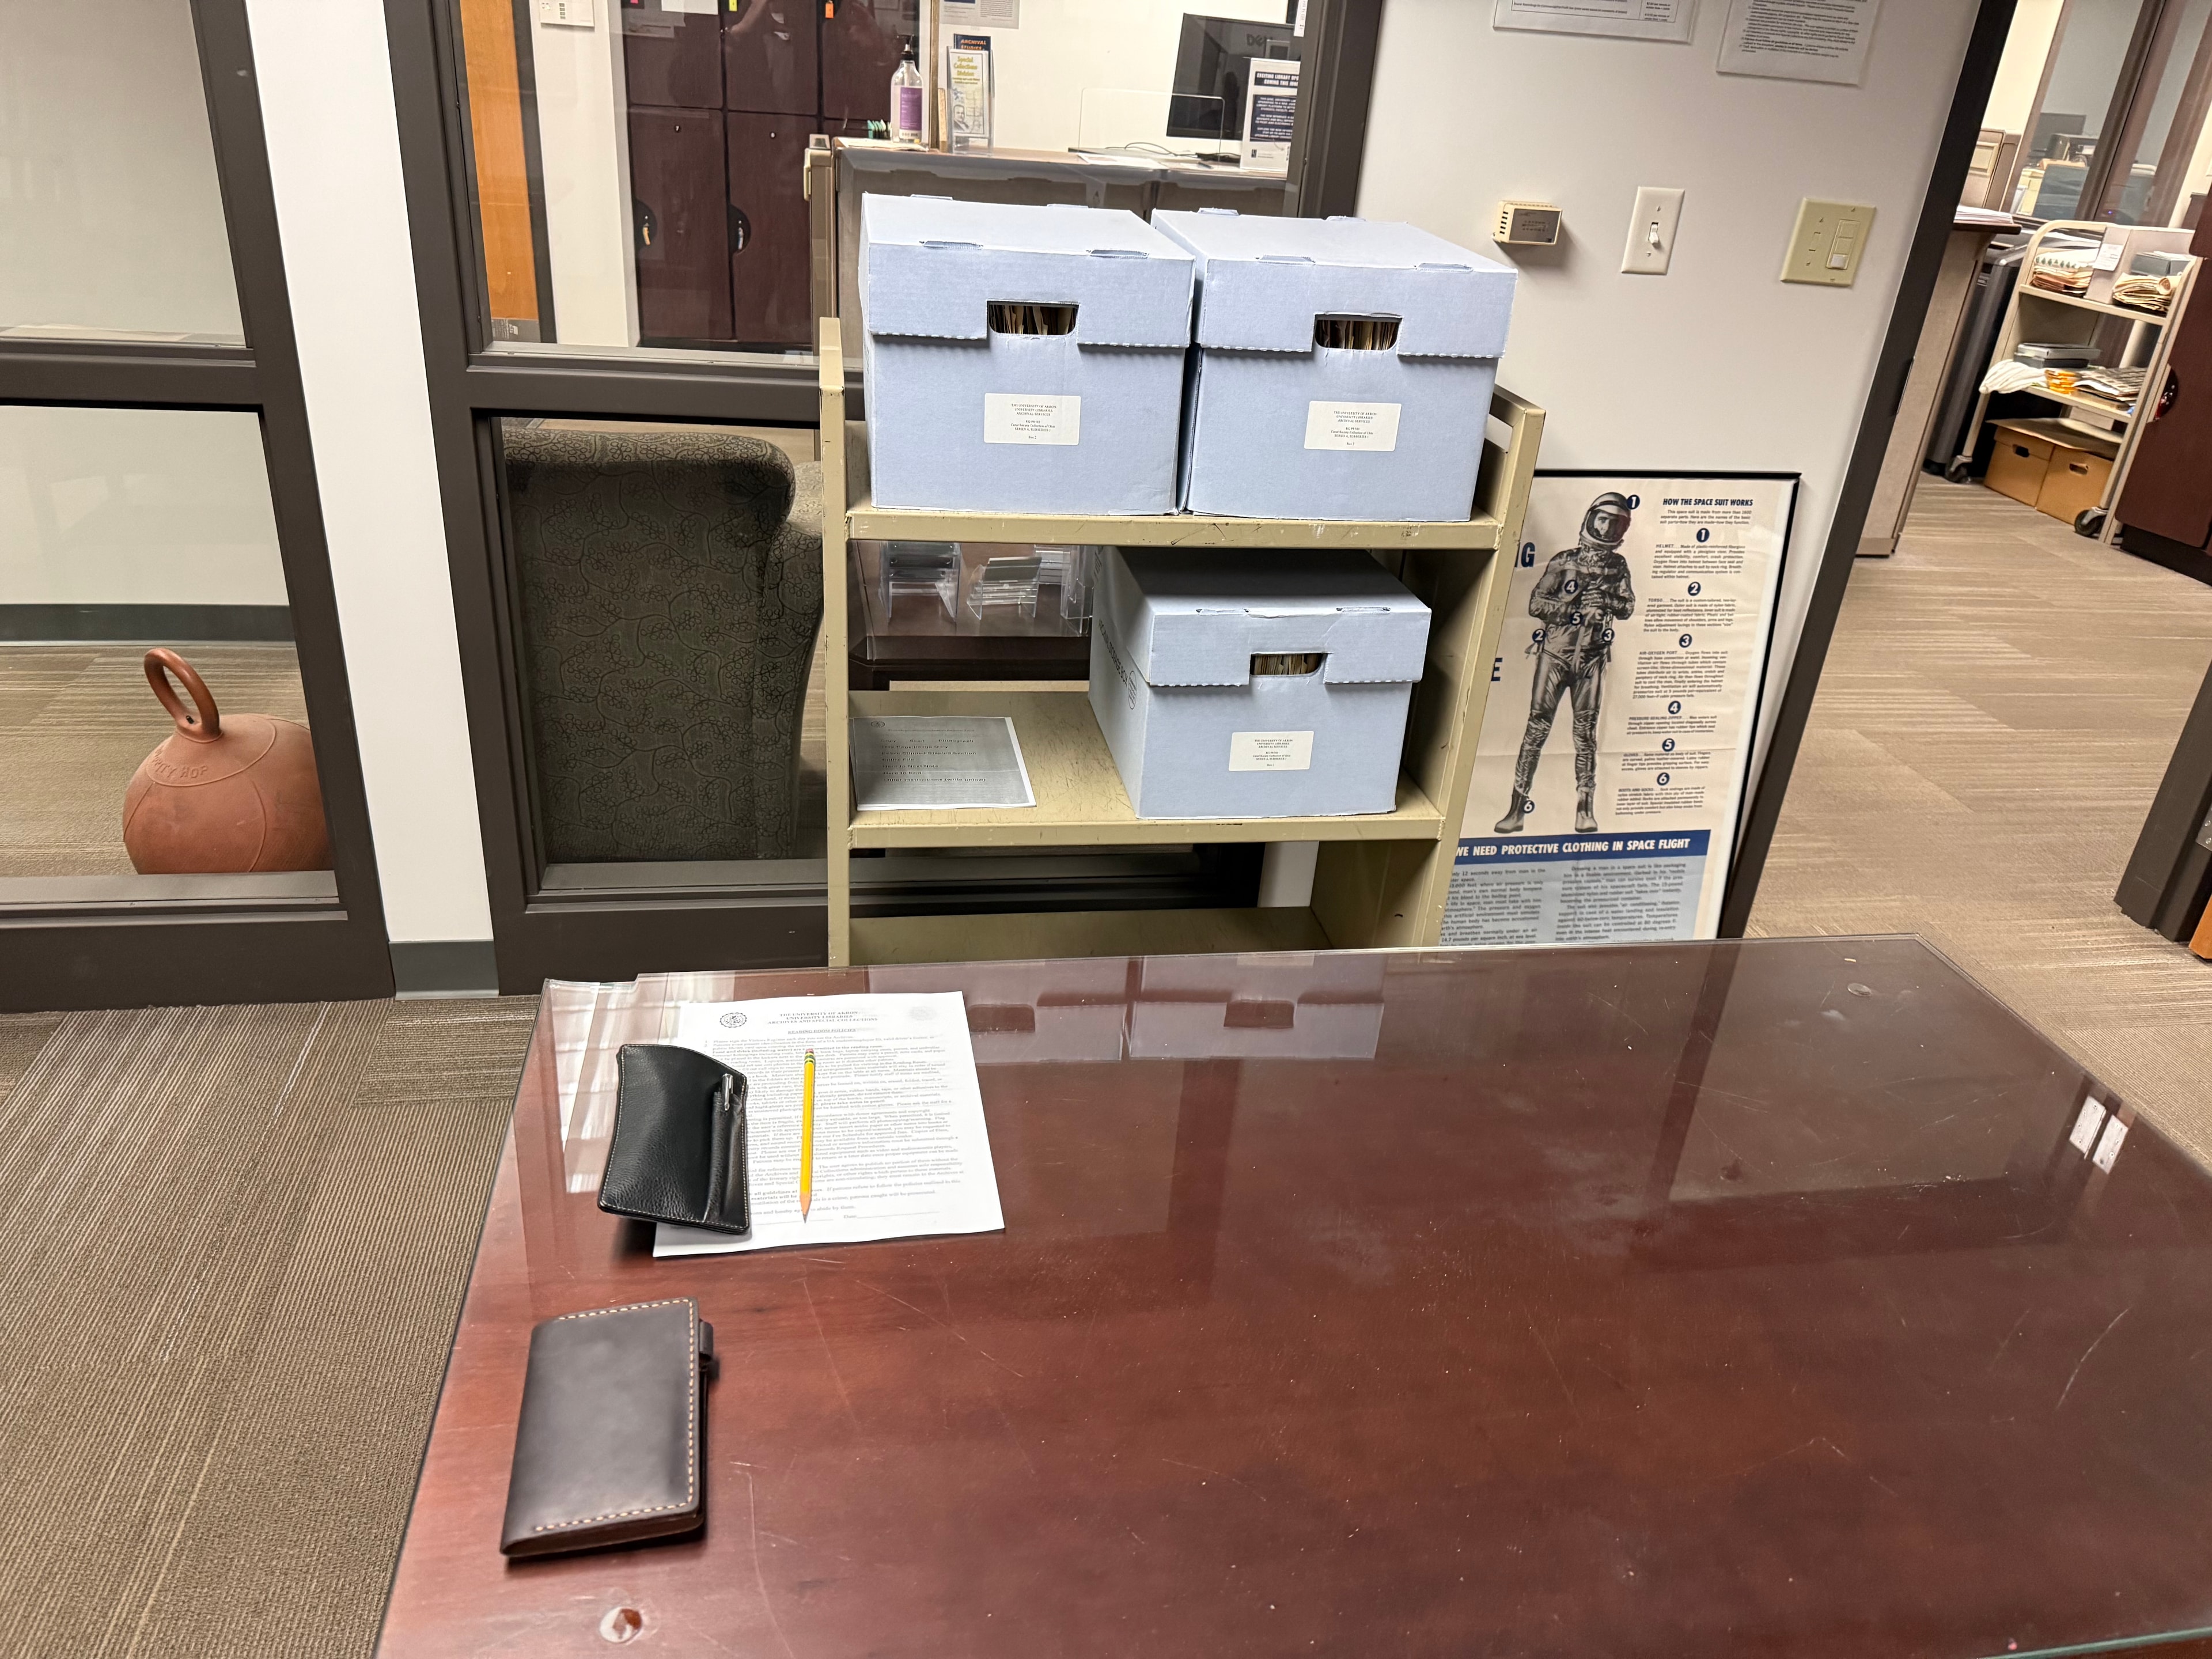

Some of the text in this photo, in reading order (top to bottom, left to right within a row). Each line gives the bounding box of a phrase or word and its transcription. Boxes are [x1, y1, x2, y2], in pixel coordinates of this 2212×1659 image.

[1631, 497, 1637, 508] 1
[1701, 529, 1706, 540] 1
[1566, 582, 1575, 592] 4
[1690, 583, 1698, 594] 2
[1572, 613, 1581, 624] 5
[1535, 630, 1544, 641] 2
[1604, 631, 1612, 641] 3
[1681, 635, 1690, 646] 3
[1669, 703, 1679, 713] 4
[1664, 740, 1672, 750] 5
[180, 765, 208, 778] HOP
[1659, 774, 1667, 783] 6
[1524, 801, 1533, 812] 6
[1473, 846, 1497, 855] NEED
[1501, 844, 1558, 854] PROTECTIVE
[1562, 842, 1608, 852] CLOTHING
[1612, 841, 1623, 851] IN
[1627, 840, 1655, 850] SPACE
[1658, 839, 1690, 849] FLIGHT
